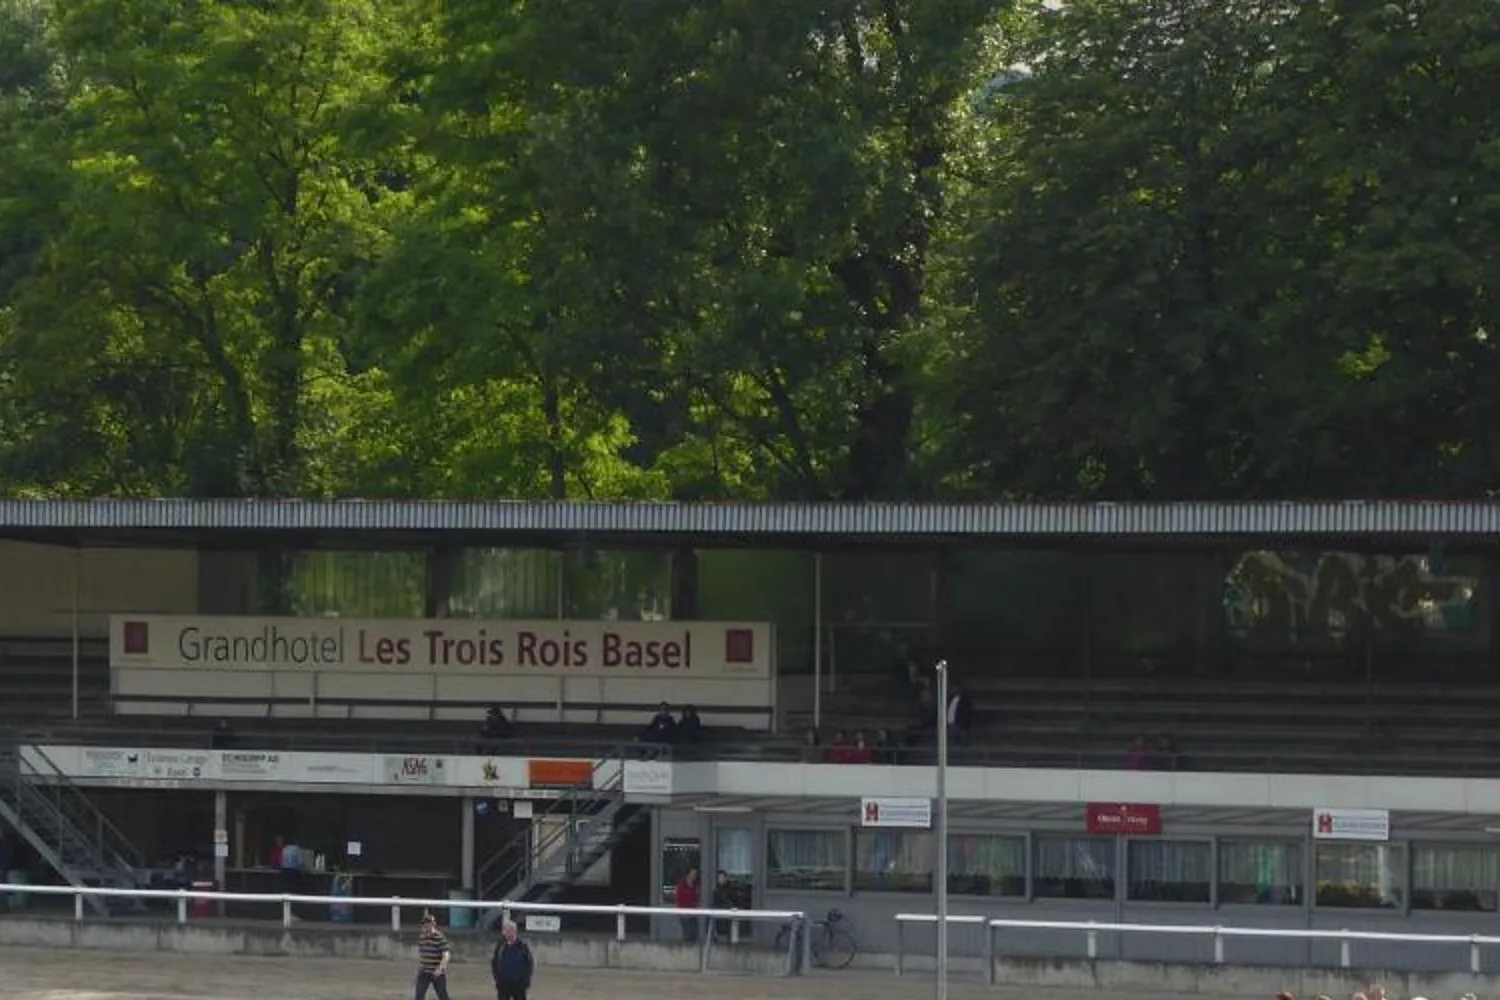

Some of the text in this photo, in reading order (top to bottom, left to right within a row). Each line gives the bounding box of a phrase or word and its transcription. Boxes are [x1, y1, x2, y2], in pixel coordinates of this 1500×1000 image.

[178, 625, 691, 669] Grandhotel Les Trois Rois Basel
